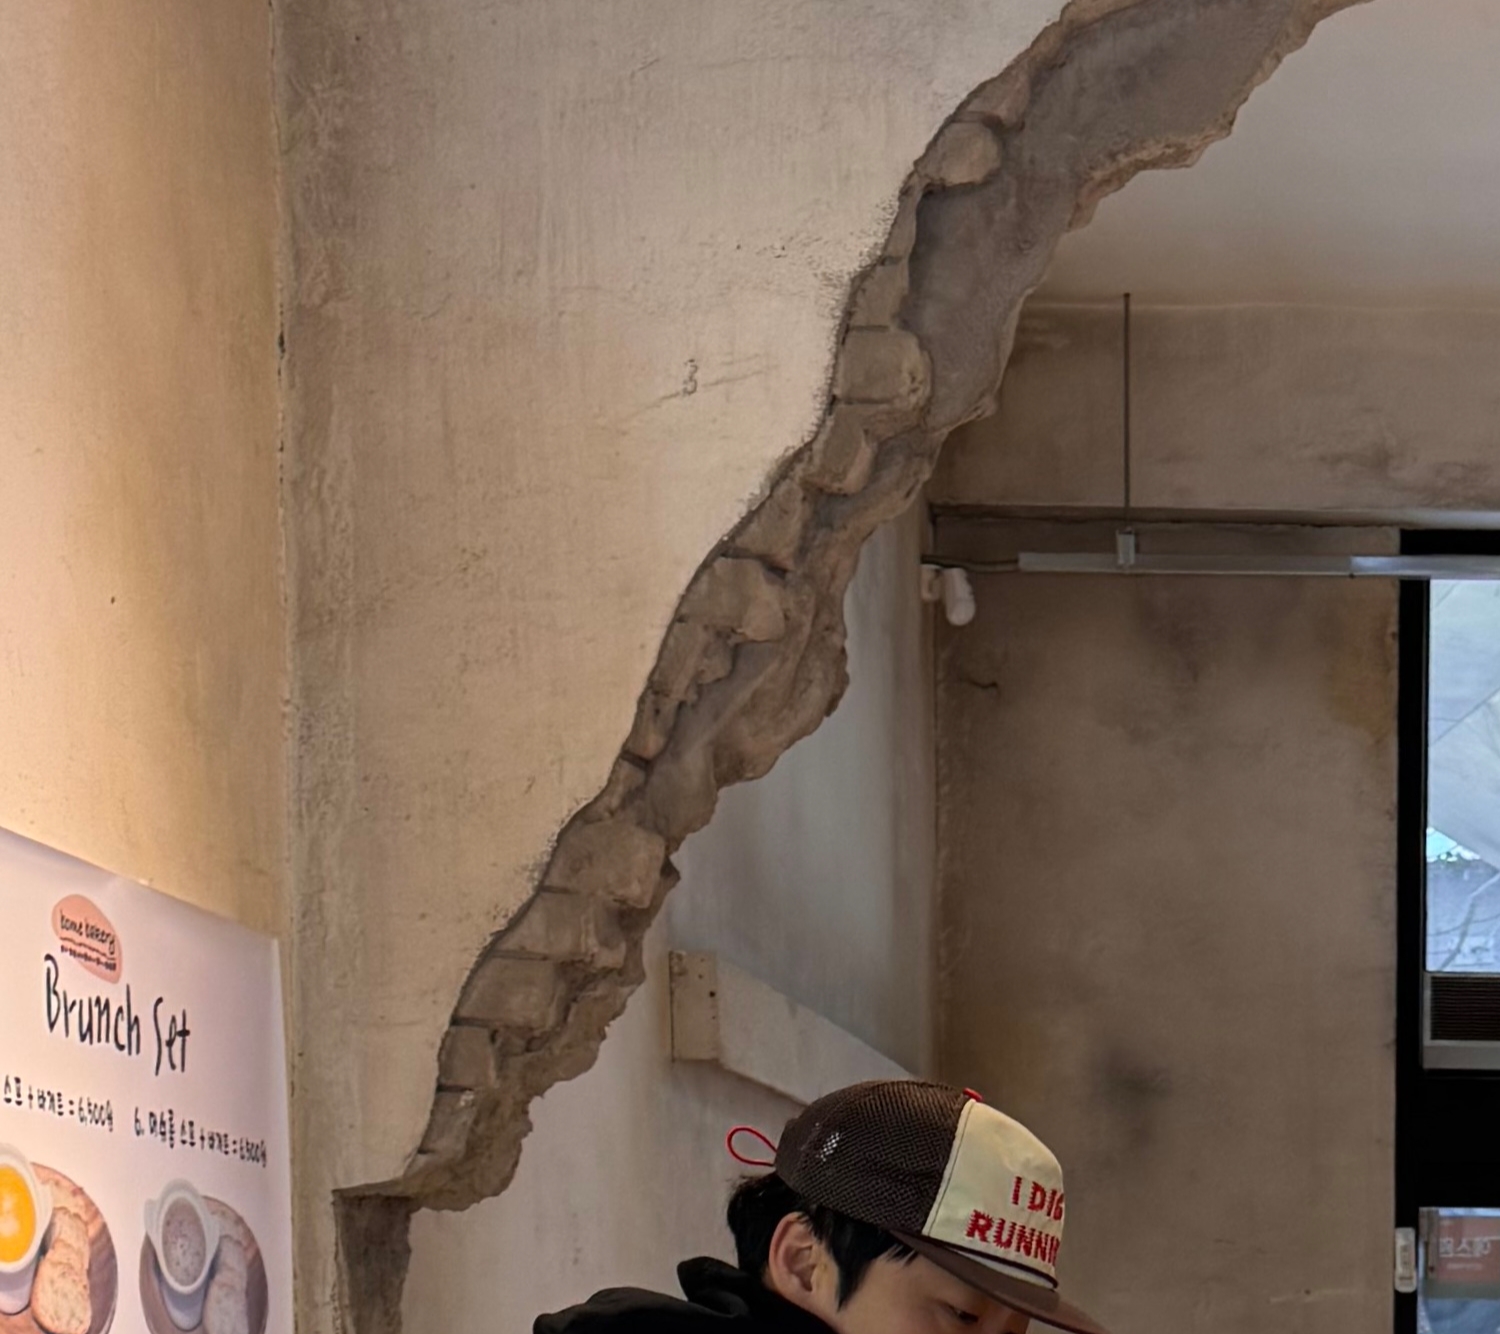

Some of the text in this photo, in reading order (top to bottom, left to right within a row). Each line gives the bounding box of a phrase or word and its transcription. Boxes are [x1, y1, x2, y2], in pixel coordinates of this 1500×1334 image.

[44, 953, 191, 1076] Brunch Set
[4, 1074, 23, 1106] 스프
[1012, 1176, 1064, 1221] I DIG
